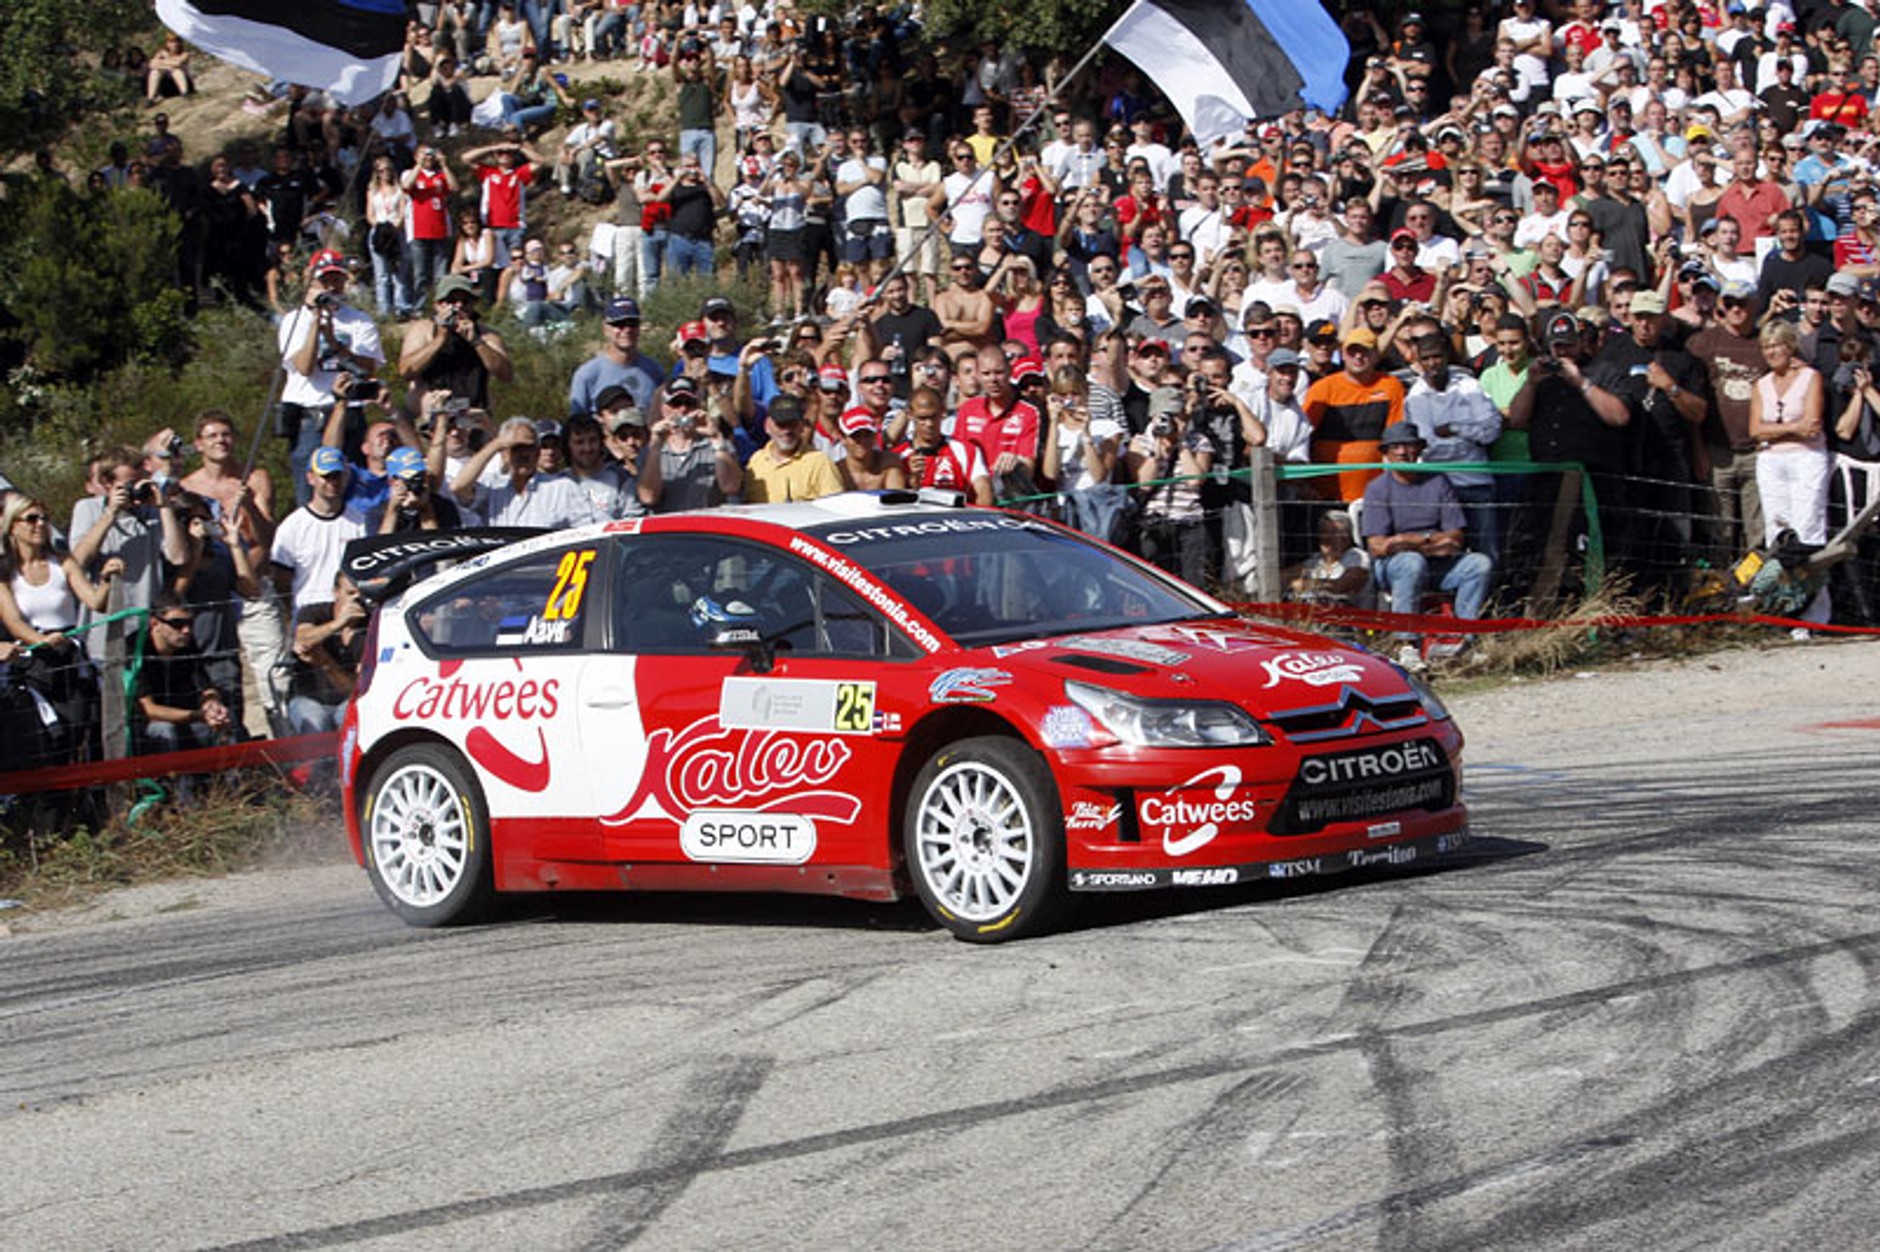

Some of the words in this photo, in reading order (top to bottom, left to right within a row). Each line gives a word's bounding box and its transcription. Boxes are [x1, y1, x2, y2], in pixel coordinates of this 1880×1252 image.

[544, 550, 597, 621] 25
[789, 536, 941, 654] www.visitestonia.com
[392, 676, 560, 720] Catwees
[835, 684, 872, 731] 25
[600, 714, 851, 826] Kalev
[1302, 742, 1438, 784] CITROËN
[1140, 797, 1255, 825] Catwees
[698, 823, 799, 849] SPORT
